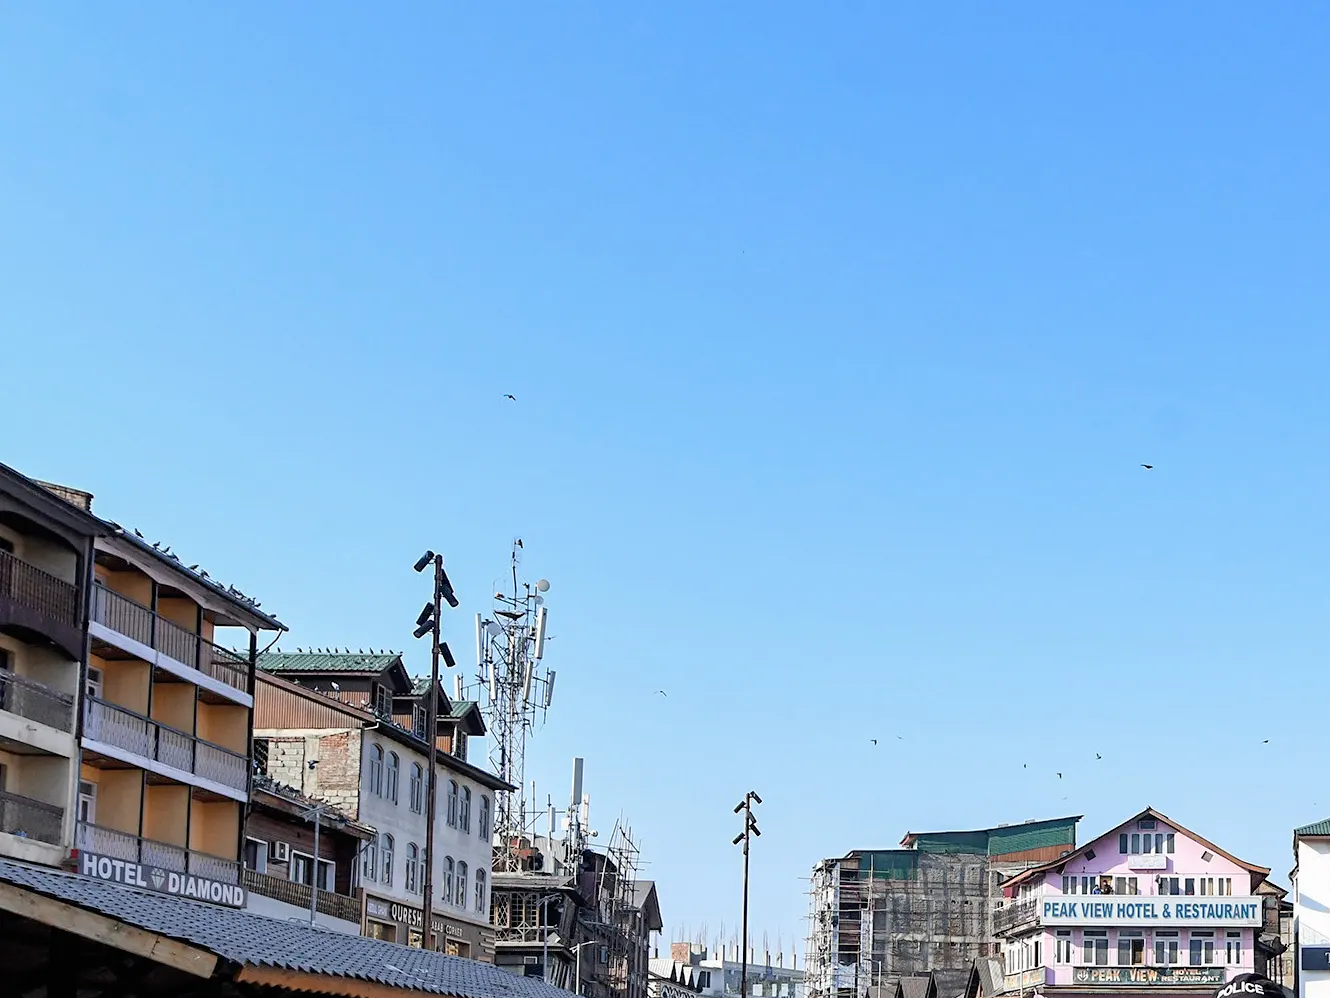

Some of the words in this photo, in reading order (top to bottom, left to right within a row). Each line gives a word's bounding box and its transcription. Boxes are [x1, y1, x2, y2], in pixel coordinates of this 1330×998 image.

[83, 853, 147, 887] HOTEL
[168, 872, 244, 906] DIAMOND
[391, 904, 424, 927] QURESH
[431, 921, 444, 933] ABAB
[1043, 903, 1078, 918] PEAK
[1081, 903, 1113, 918] VIEW
[1117, 903, 1158, 918] HOTEL
[1162, 903, 1171, 918] &
[1175, 903, 1257, 919] RESTAURANT
[1091, 969, 1121, 982] PEAK
[1129, 968, 1157, 982] VIEW
